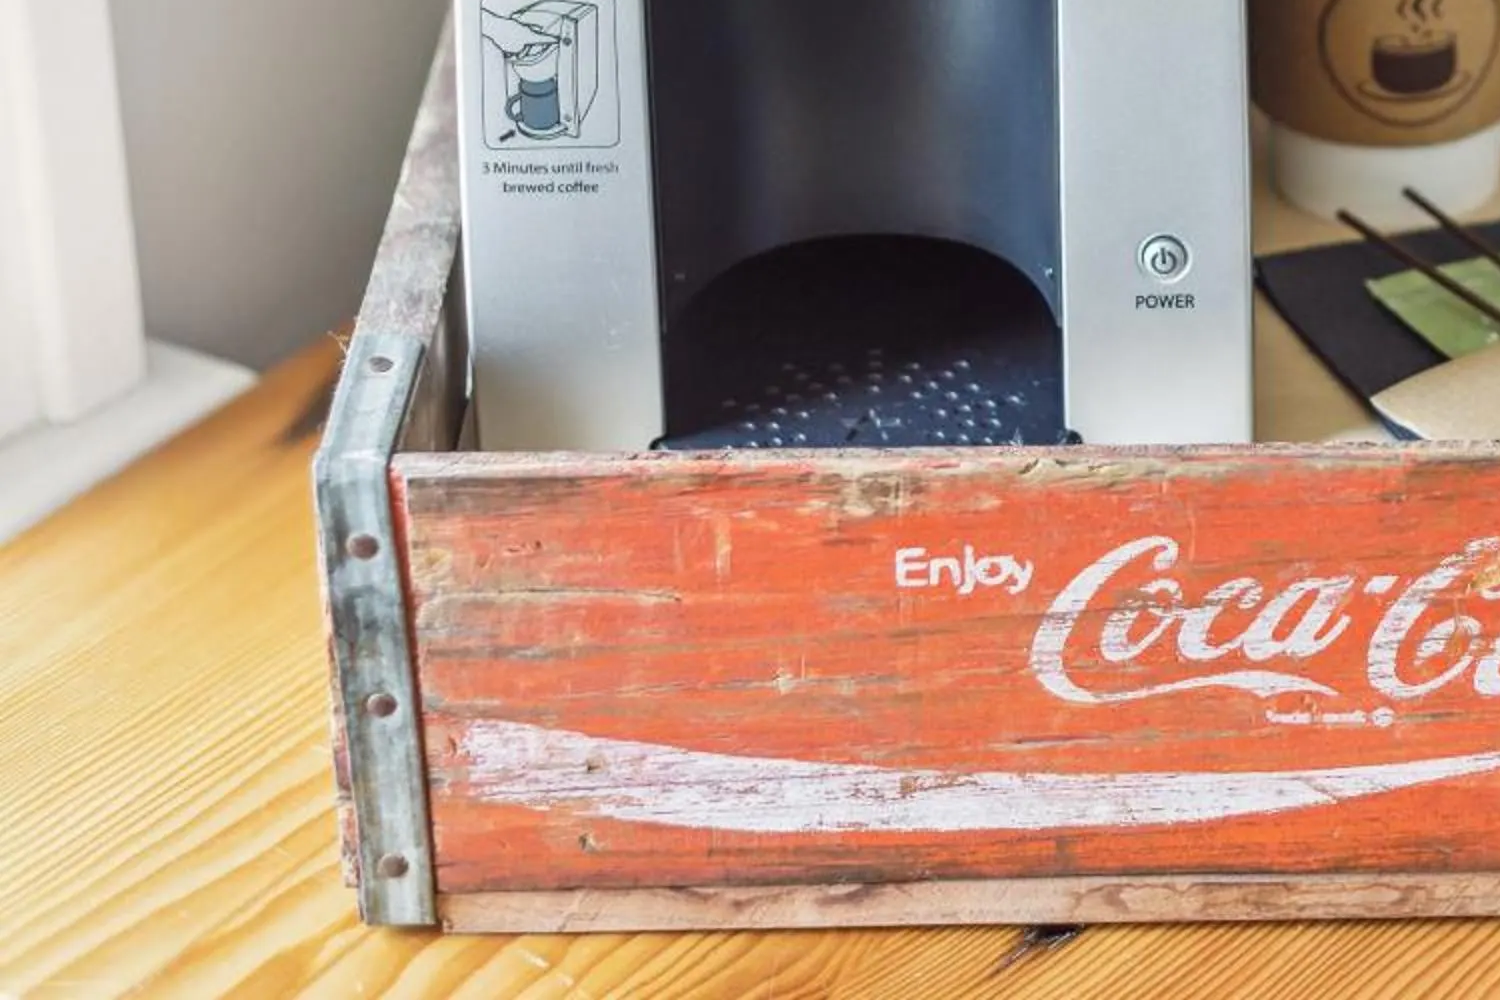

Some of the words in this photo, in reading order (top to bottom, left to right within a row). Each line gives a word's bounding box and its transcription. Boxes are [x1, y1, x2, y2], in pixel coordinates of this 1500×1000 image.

[482, 161, 490, 174] 3
[494, 161, 549, 174] Minutes
[551, 160, 583, 174] until
[585, 160, 619, 174] fresh
[503, 180, 555, 194] brewed
[557, 180, 599, 194] coffee
[1135, 294, 1195, 310] POWER
[895, 545, 1034, 595] Enjoy
